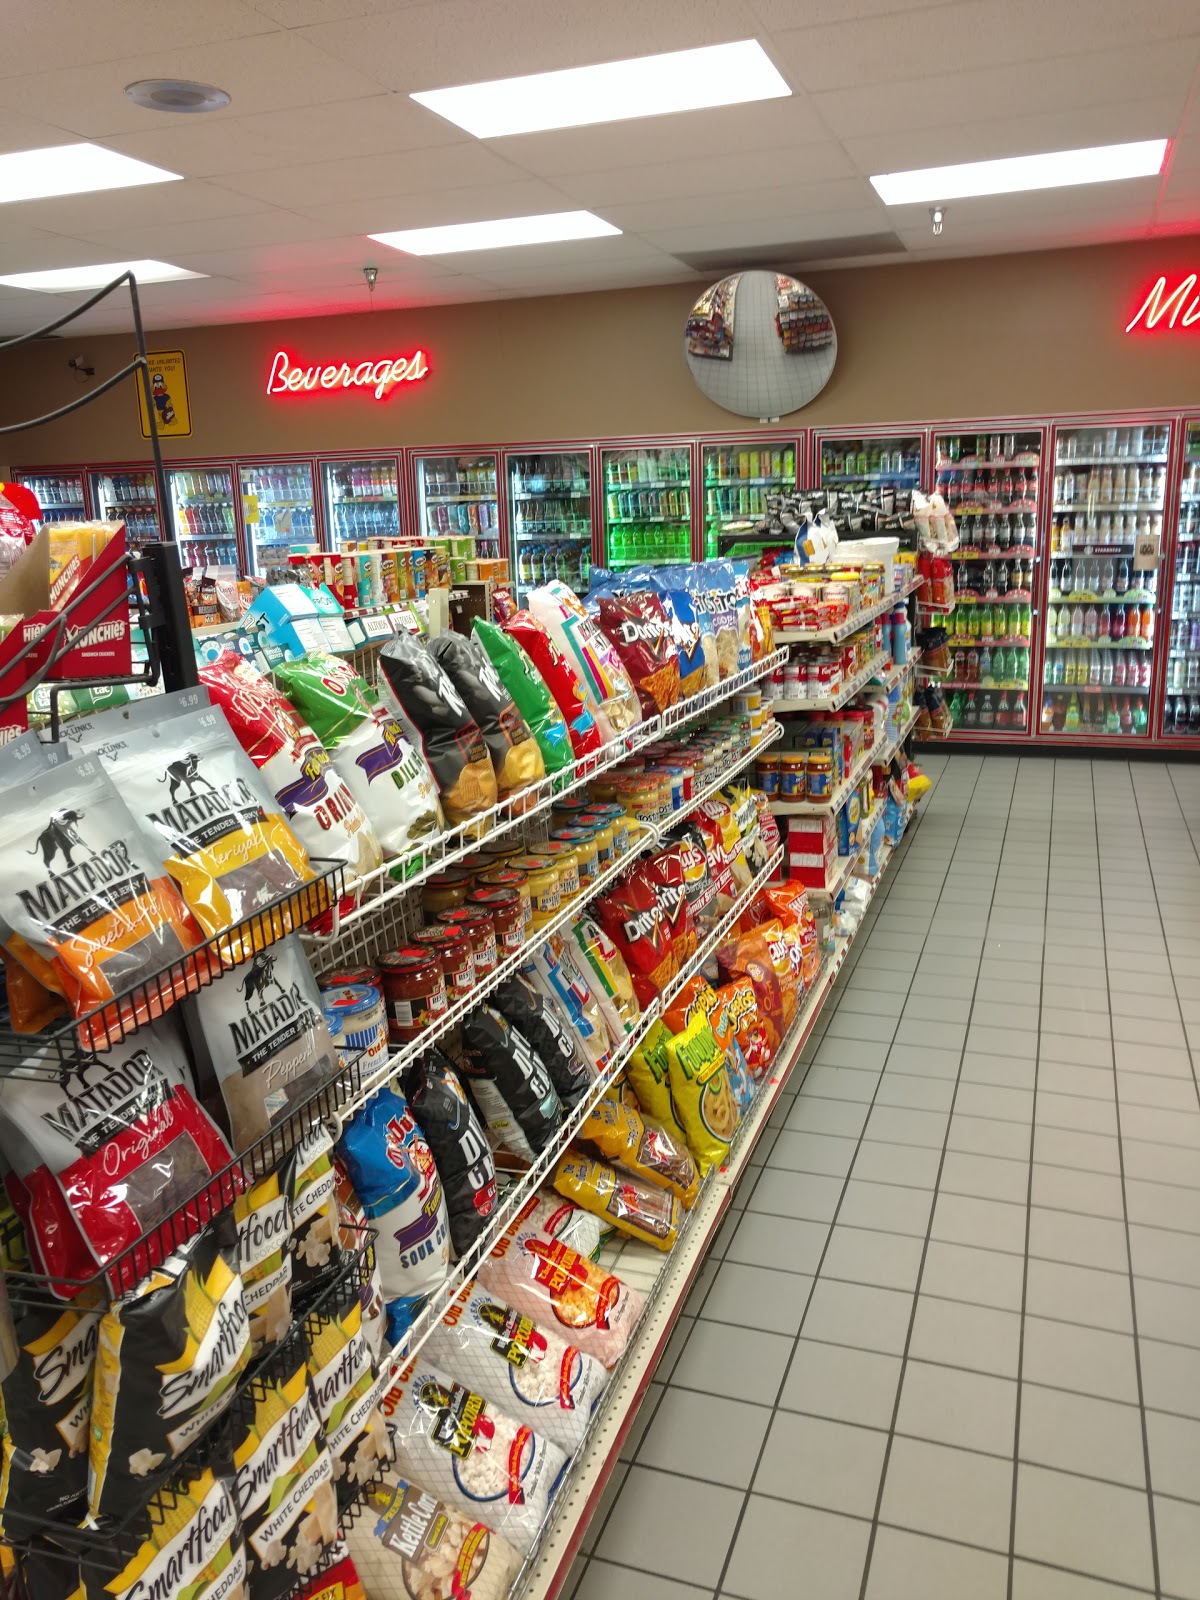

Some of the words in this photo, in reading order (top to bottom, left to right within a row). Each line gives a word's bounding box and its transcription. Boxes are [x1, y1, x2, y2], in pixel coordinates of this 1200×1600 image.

[267, 350, 428, 399] Beverages
[202, 818, 236, 838] TENDER
[16, 839, 140, 921] MATADOR
[59, 915, 82, 933] THE
[82, 891, 119, 917] TENDER
[118, 880, 141, 896] JERKY
[71, 921, 123, 968] Sweet
[252, 1048, 268, 1063] THE
[268, 1027, 296, 1051] TENDER
[40, 1048, 164, 1145] MATADOR
[103, 1103, 175, 1177] Original
[401, 1239, 435, 1269] SOUR
[157, 1291, 248, 1416] Smartfood
[507, 1315, 534, 1365] POPCORN
[314, 1339, 368, 1412] martfood
[450, 1392, 483, 1457] POPCORN
[259, 1501, 294, 1543] WHITE
[293, 1458, 329, 1498] CHEDDAR
[390, 1513, 427, 1558] Kettle
